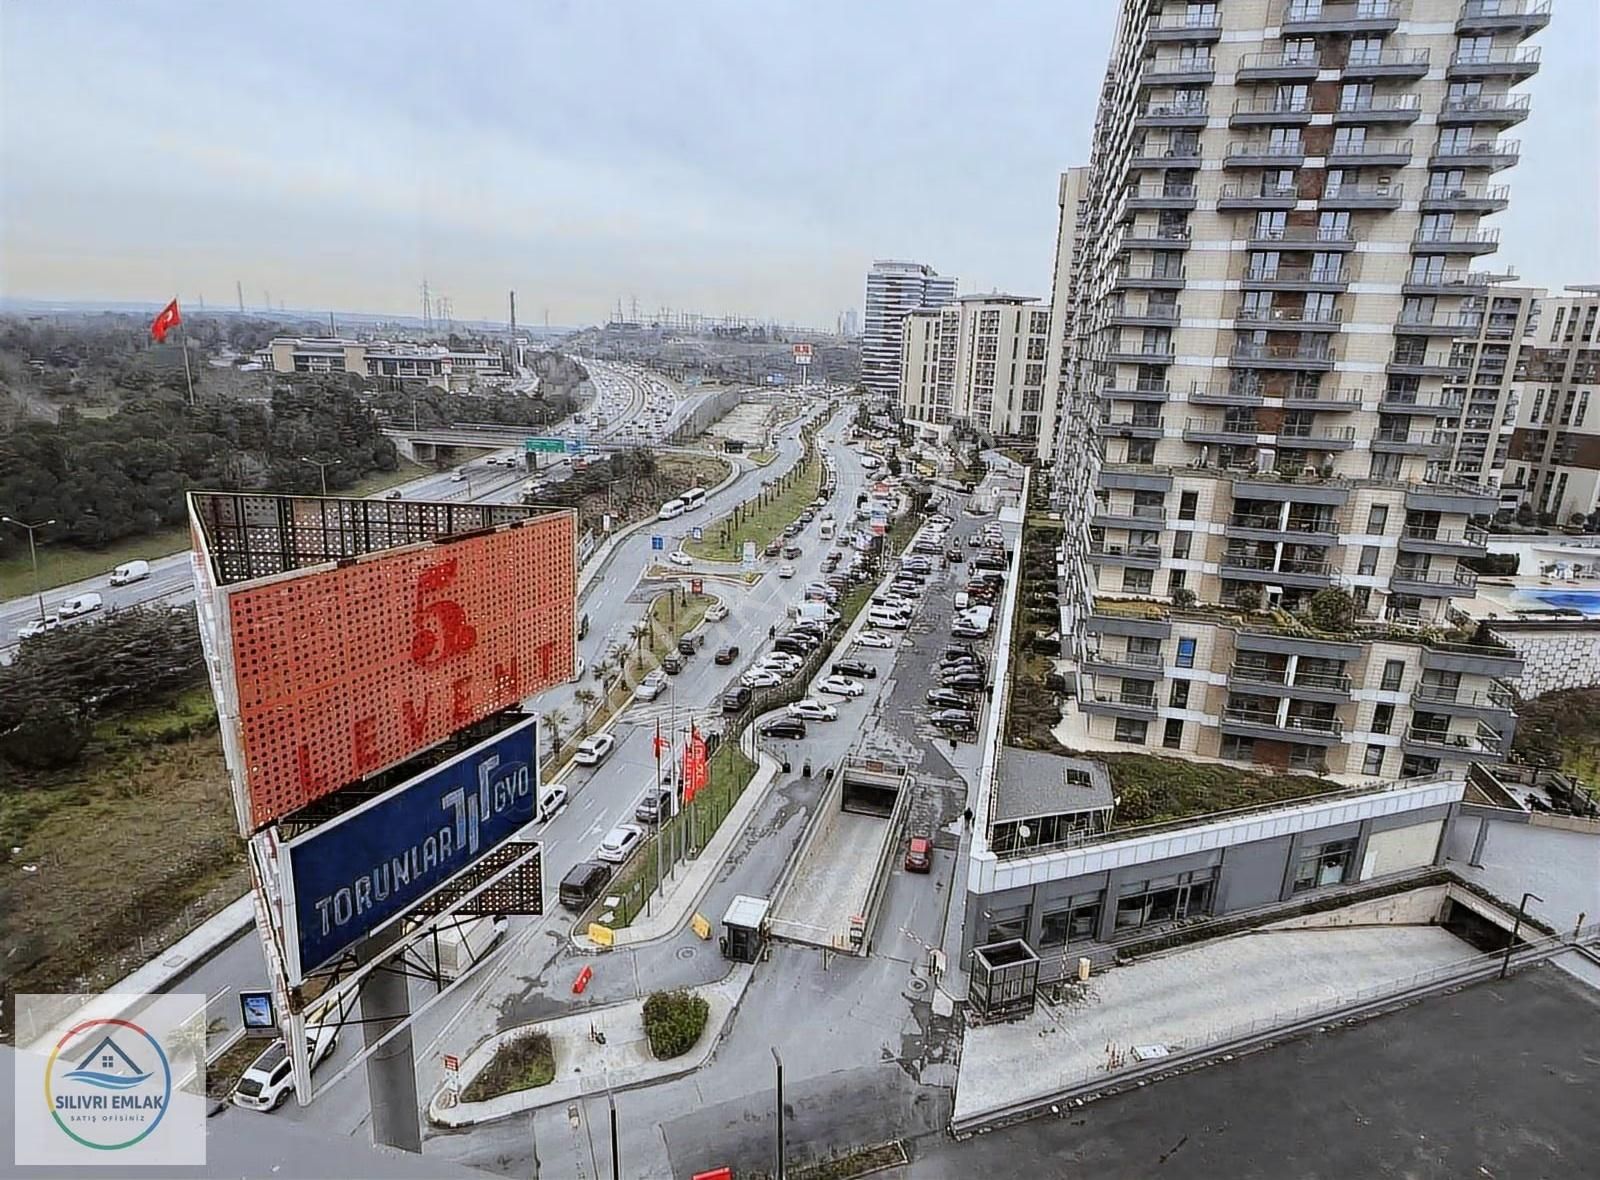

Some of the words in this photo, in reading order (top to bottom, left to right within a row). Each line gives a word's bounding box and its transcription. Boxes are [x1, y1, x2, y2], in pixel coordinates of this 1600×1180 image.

[296, 640, 558, 795] LEVENT
[315, 826, 452, 937] TORUNLAR
[494, 765, 529, 813] GYO
